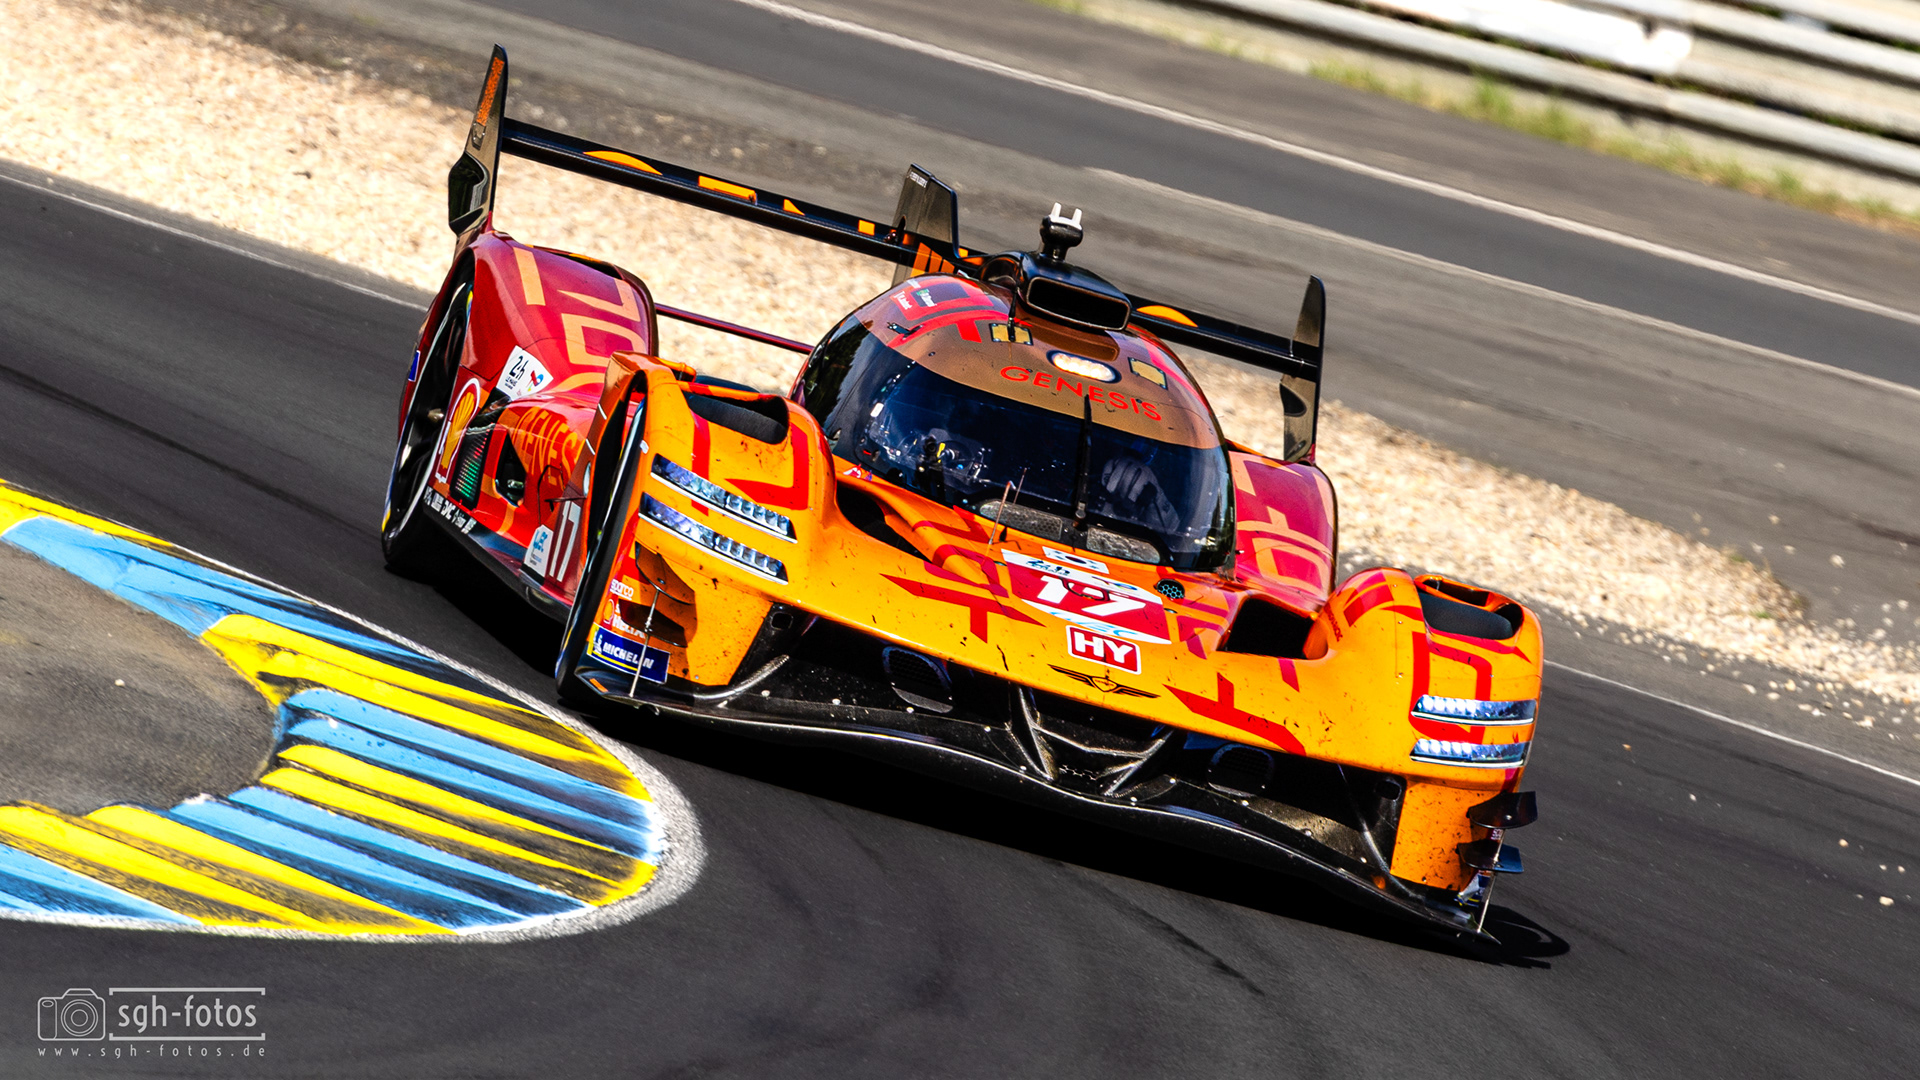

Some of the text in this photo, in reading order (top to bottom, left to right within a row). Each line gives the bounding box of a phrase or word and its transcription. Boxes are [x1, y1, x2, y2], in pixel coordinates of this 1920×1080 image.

[1000, 365, 1163, 422] GENESIS
[548, 500, 582, 583] 17
[1037, 574, 1146, 617] 17
[602, 641, 655, 669] MICHELN
[1073, 631, 1134, 664] HY
